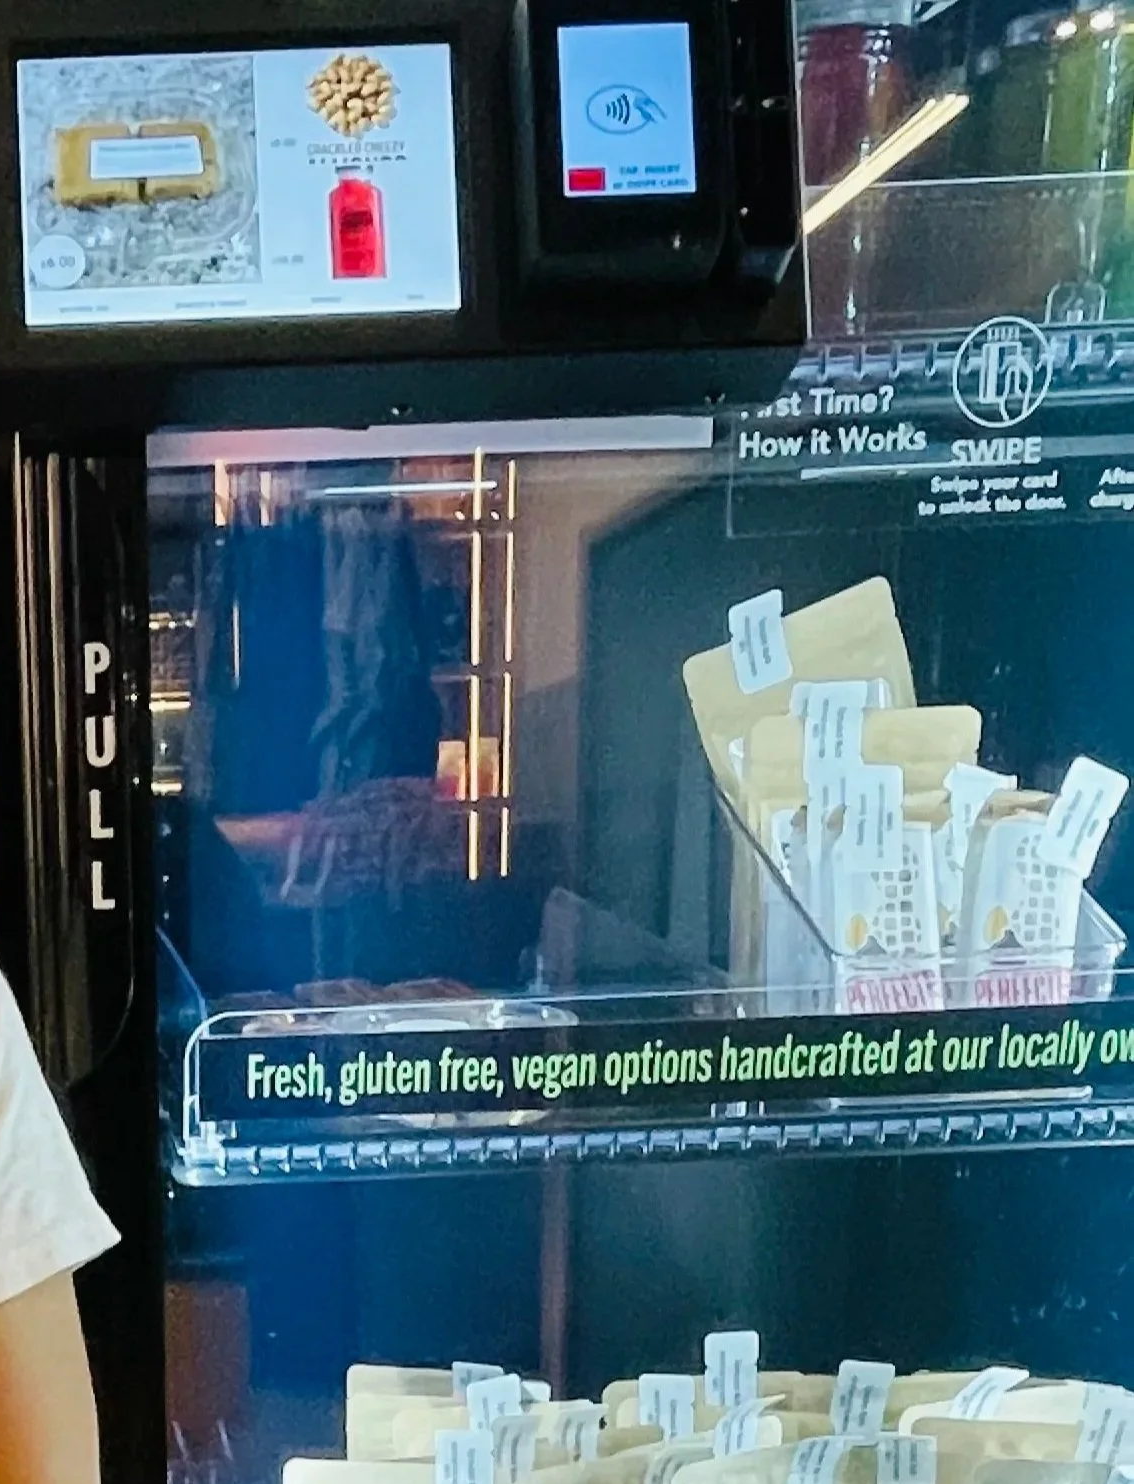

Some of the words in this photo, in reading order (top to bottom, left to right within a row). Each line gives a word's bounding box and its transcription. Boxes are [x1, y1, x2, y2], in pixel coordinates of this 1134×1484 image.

[809, 385, 894, 416] Time?
[739, 431, 804, 459] How
[811, 428, 832, 455] it
[838, 422, 927, 453] Works
[951, 436, 1043, 466] SWIPE
[918, 500, 936, 517] to
[994, 494, 1022, 513] the
[83, 640, 117, 911] PULL
[247, 1052, 333, 1104] Fresh,
[338, 1050, 432, 1106] gluten
[439, 1046, 505, 1099] free,
[512, 1052, 597, 1099] vegan
[604, 1038, 714, 1095] options
[720, 1029, 902, 1081] handcrafted
[904, 1029, 938, 1074] at
[942, 1035, 994, 1073] our
[998, 1019, 1096, 1075] locally
